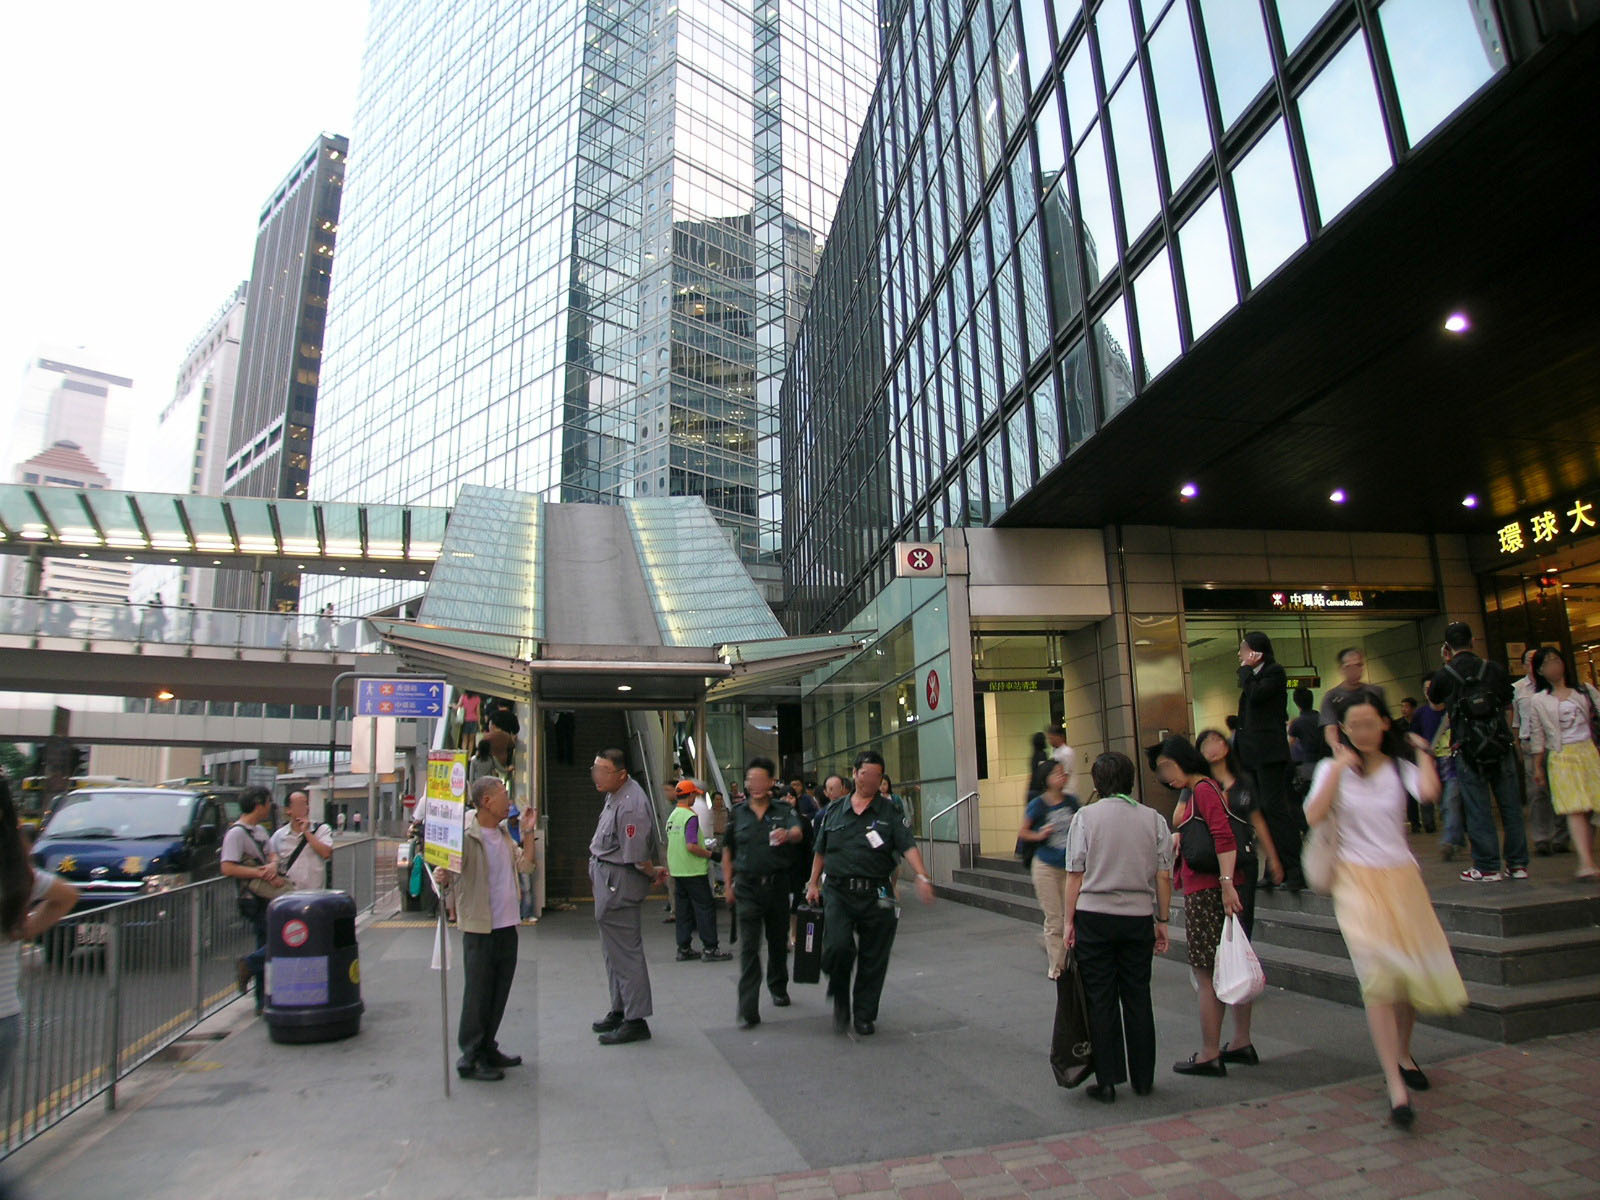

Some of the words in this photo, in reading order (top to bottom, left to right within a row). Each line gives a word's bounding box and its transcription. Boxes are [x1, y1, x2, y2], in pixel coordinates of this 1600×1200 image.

[1497, 500, 1596, 553] 環球大
[1290, 592, 1325, 606] 中環站
